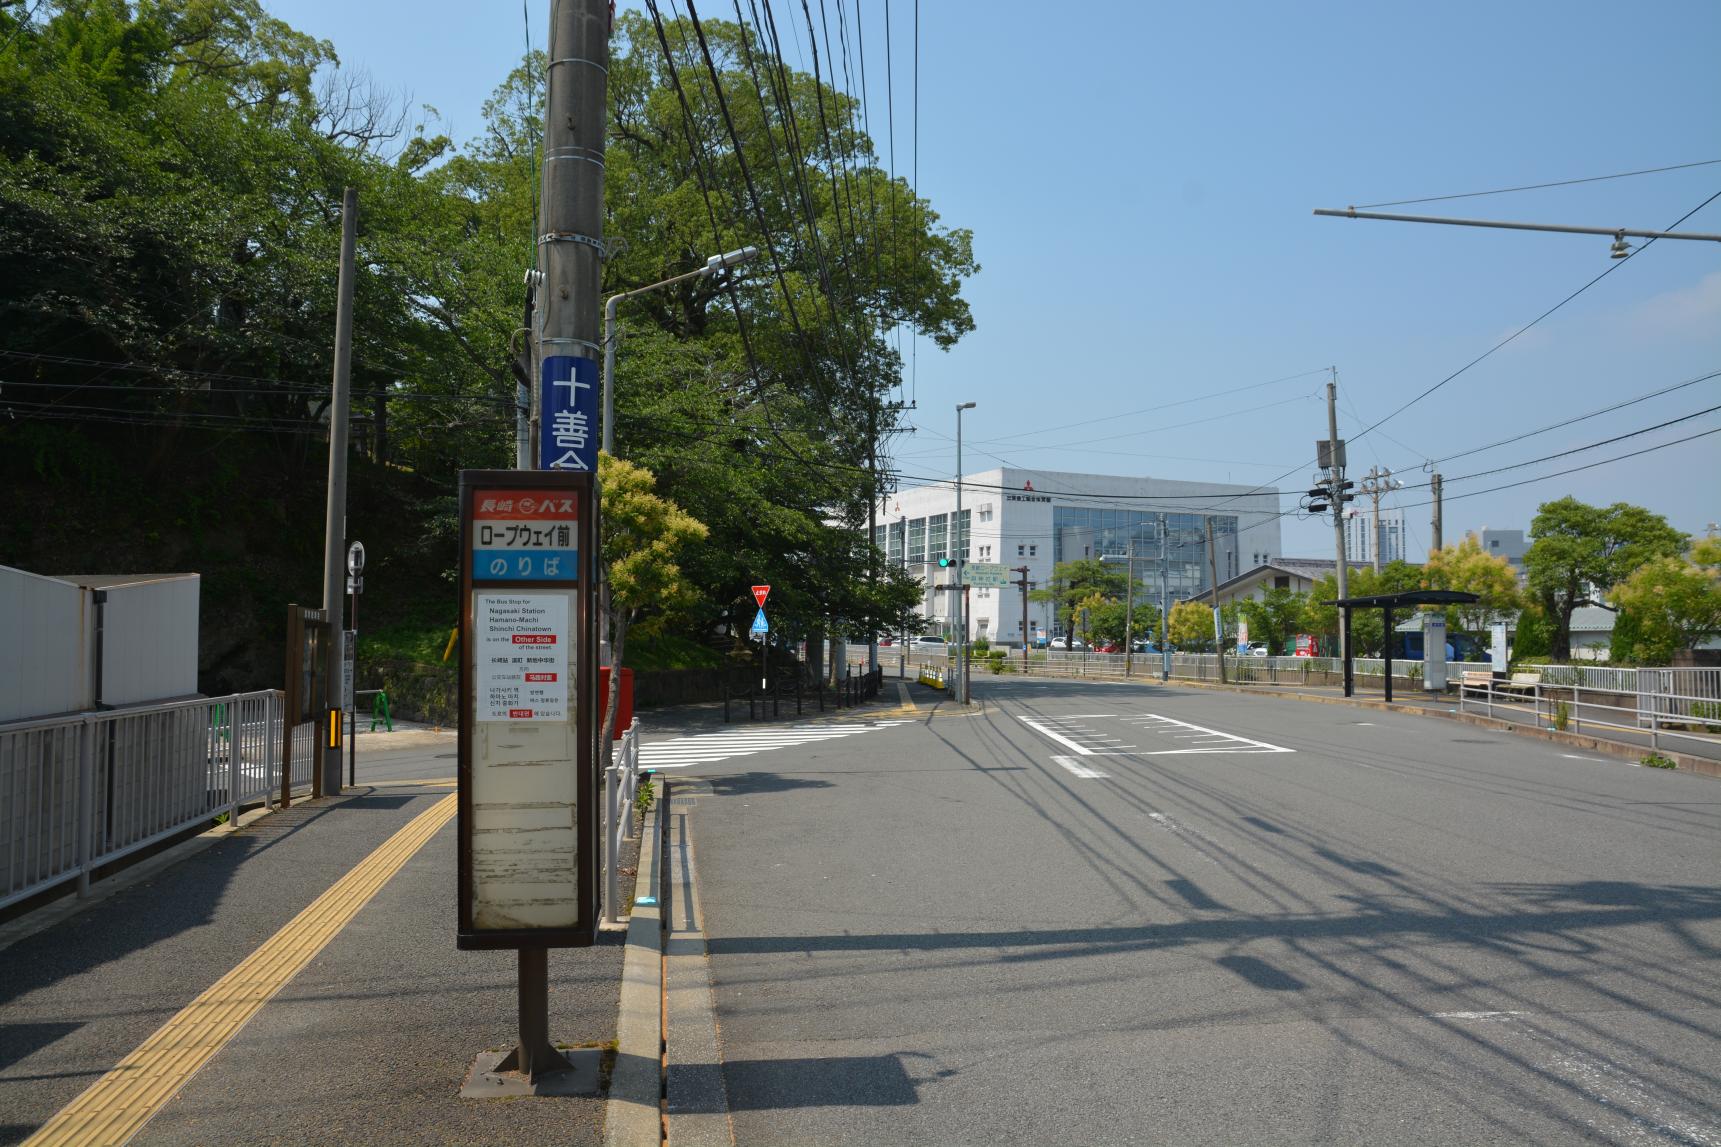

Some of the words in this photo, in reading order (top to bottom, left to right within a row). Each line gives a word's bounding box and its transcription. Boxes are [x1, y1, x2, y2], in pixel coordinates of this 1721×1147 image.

[480, 499, 513, 513] 長崎
[539, 499, 574, 513] バス
[480, 524, 570, 547] ロープウェイ前
[490, 556, 561, 576] のりば
